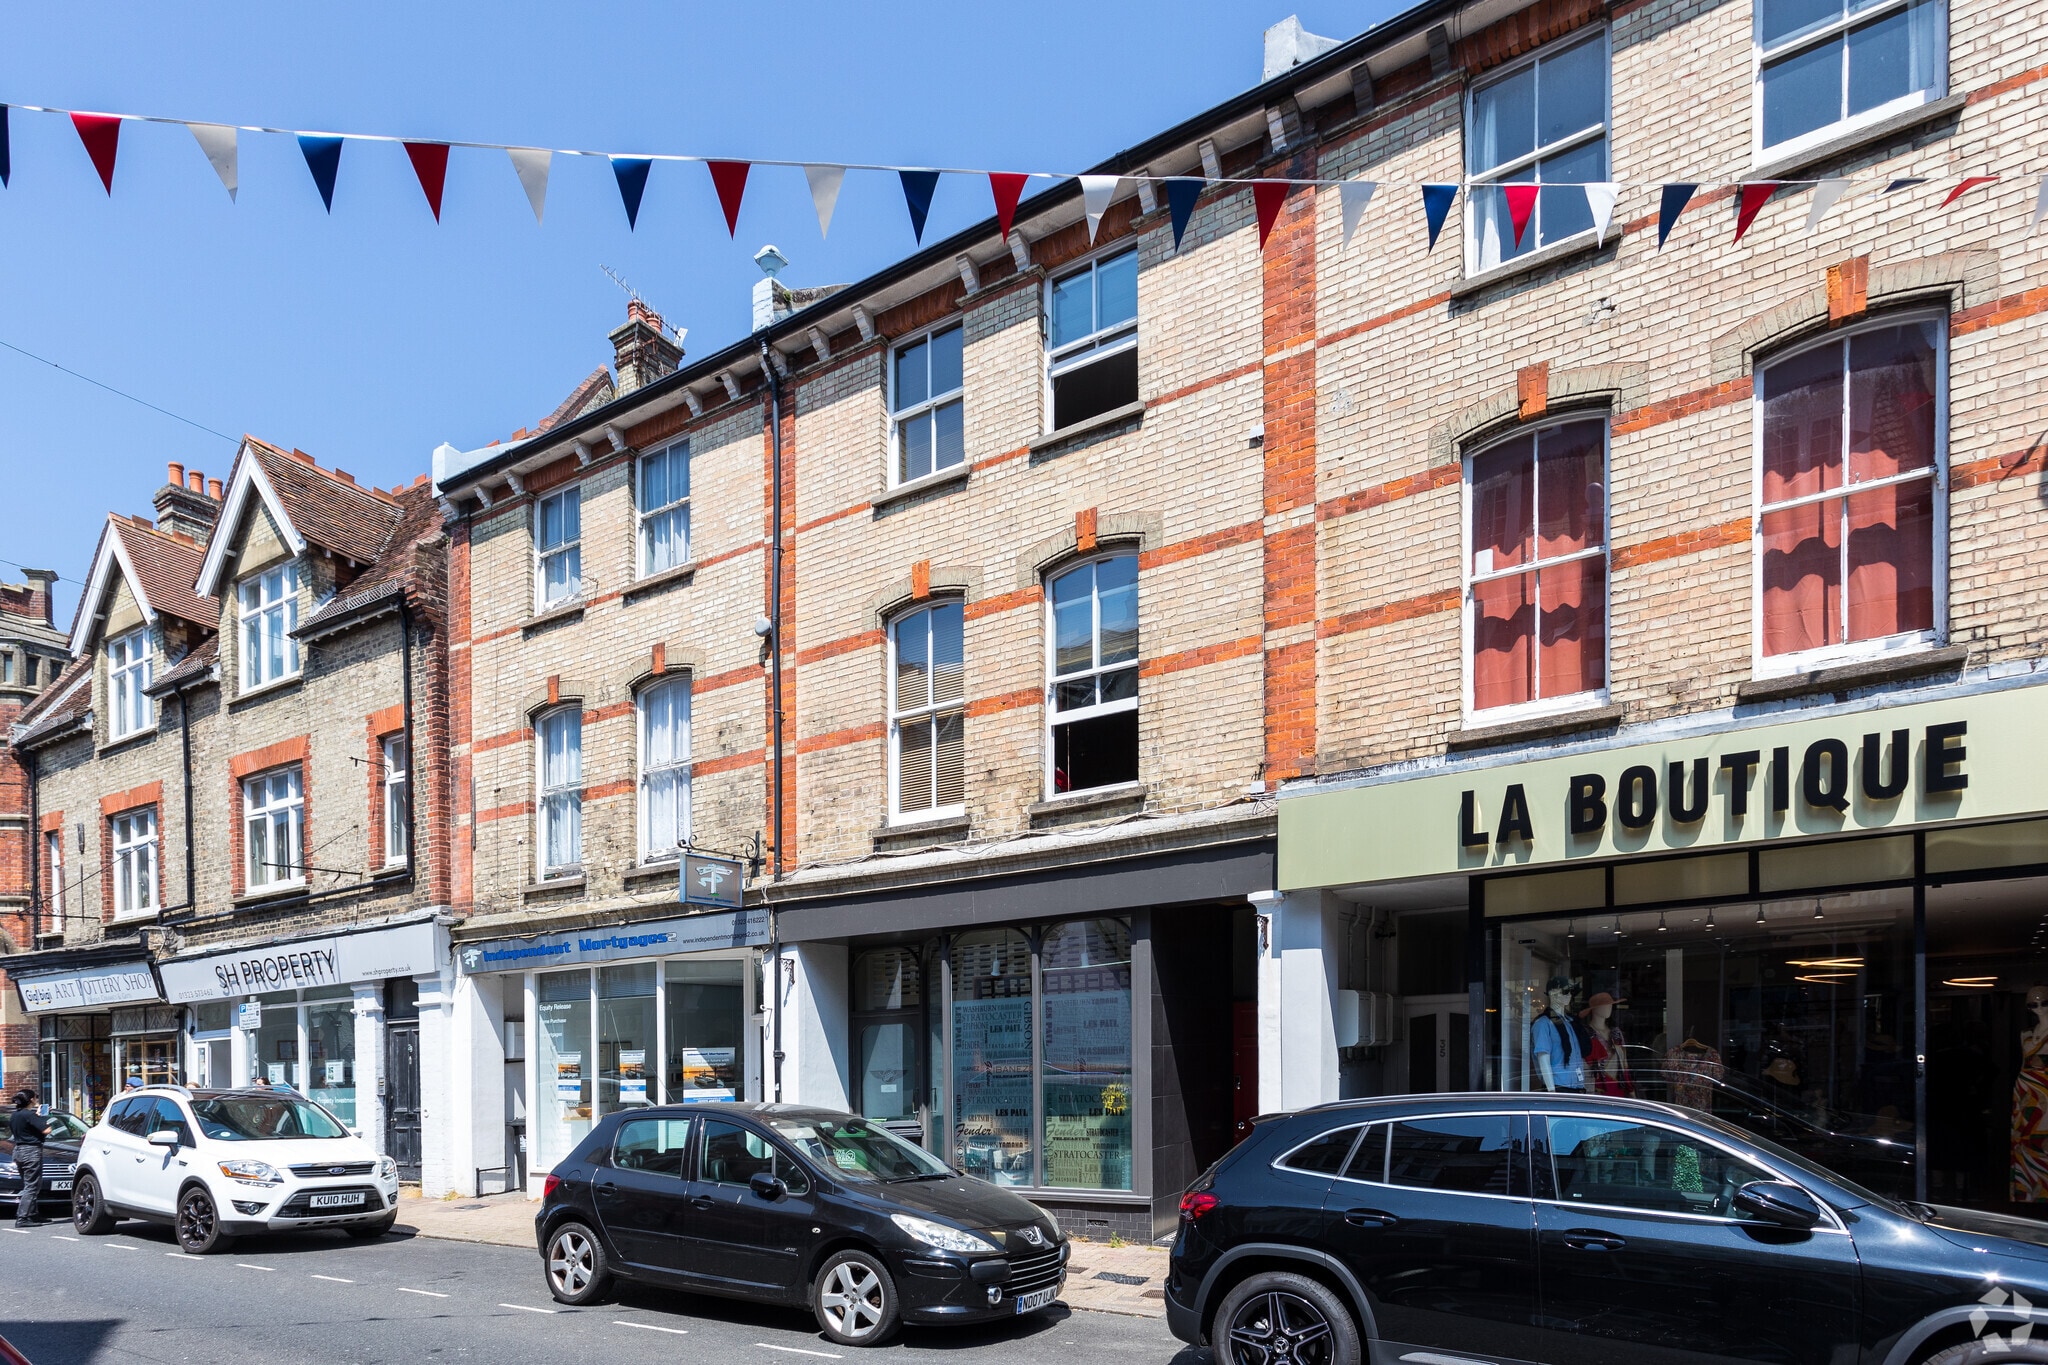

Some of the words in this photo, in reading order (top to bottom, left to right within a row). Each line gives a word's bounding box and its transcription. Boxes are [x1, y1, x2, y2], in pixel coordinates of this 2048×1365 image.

[1461, 783, 1534, 847] LA
[1570, 720, 1968, 835] BOUTIQUE
[483, 941, 571, 962] Independent
[215, 962, 241, 989] SH
[240, 948, 333, 985] PROPERTY
[361, 963, 412, 977] www.shproperty.co.uk
[54, 982, 76, 999] ART
[76, 977, 122, 997] POTTERY
[122, 972, 153, 991] SHOP
[539, 1004, 553, 1012] Equity
[1053, 999, 1091, 1008] WASHBURN
[1091, 997, 1119, 1005] YAMAHA
[962, 1004, 997, 1013] WASHBURN
[962, 1011, 1022, 1022] STRATOCASTER
[989, 1024, 1003, 1034] LES
[1004, 1023, 1023, 1033] PAUL
[1023, 1001, 1033, 1050] GIBSON
[1083, 1019, 1098, 1029] LES
[1099, 1019, 1119, 1029] PAUL
[1078, 1045, 1125, 1056] WASHBURN
[992, 1064, 1030, 1074] IBANEZ
[316, 1096, 334, 1106] Property
[967, 1096, 1028, 1105] STRATOCASTER
[995, 1108, 1009, 1118] LES
[1010, 1108, 1029, 1117] PAUL
[1088, 1107, 1104, 1117] LES
[955, 1123, 992, 1138] Fender
[1046, 1123, 1085, 1138] Fender
[1086, 1127, 1120, 1137] STRATOCASTER
[998, 1141, 1024, 1149] YAMAHA
[1053, 1149, 1121, 1160] STRATOCASTER
[316, 1196, 339, 1206] KU10
[341, 1194, 360, 1204] HUH
[1022, 1292, 1043, 1311] ND07
